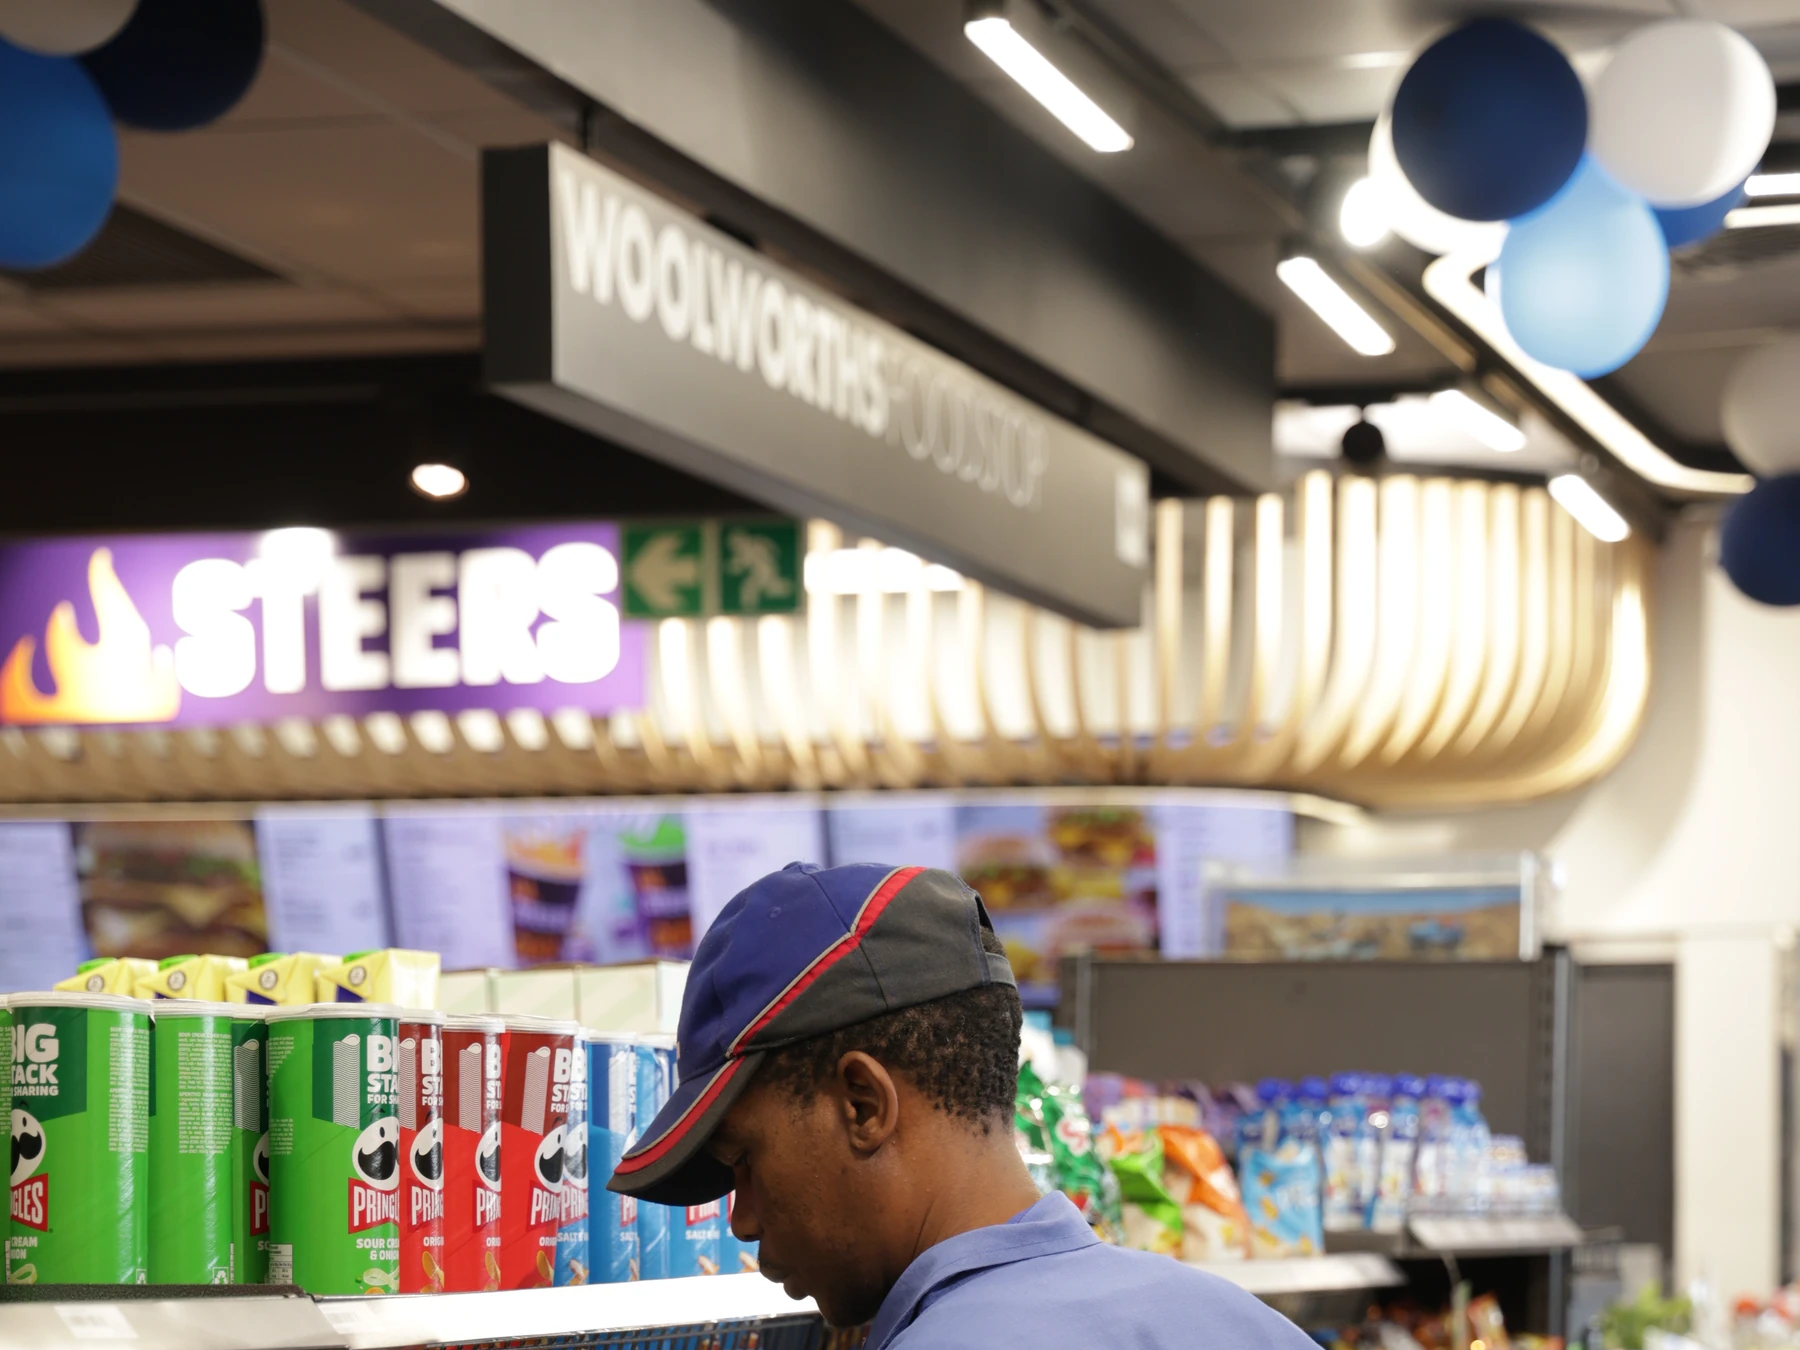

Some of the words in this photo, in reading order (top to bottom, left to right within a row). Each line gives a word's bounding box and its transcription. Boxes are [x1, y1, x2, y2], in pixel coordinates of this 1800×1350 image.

[557, 168, 890, 440] WOOLWORTHS
[172, 540, 621, 699] STEERS
[366, 1034, 398, 1073] BI
[366, 1073, 399, 1094] STA
[366, 1094, 388, 1105] FOR
[11, 1181, 44, 1225] GLES
[353, 1185, 400, 1227] PRINGL
[356, 1238, 386, 1249] SOUR
[369, 1249, 378, 1261] &
